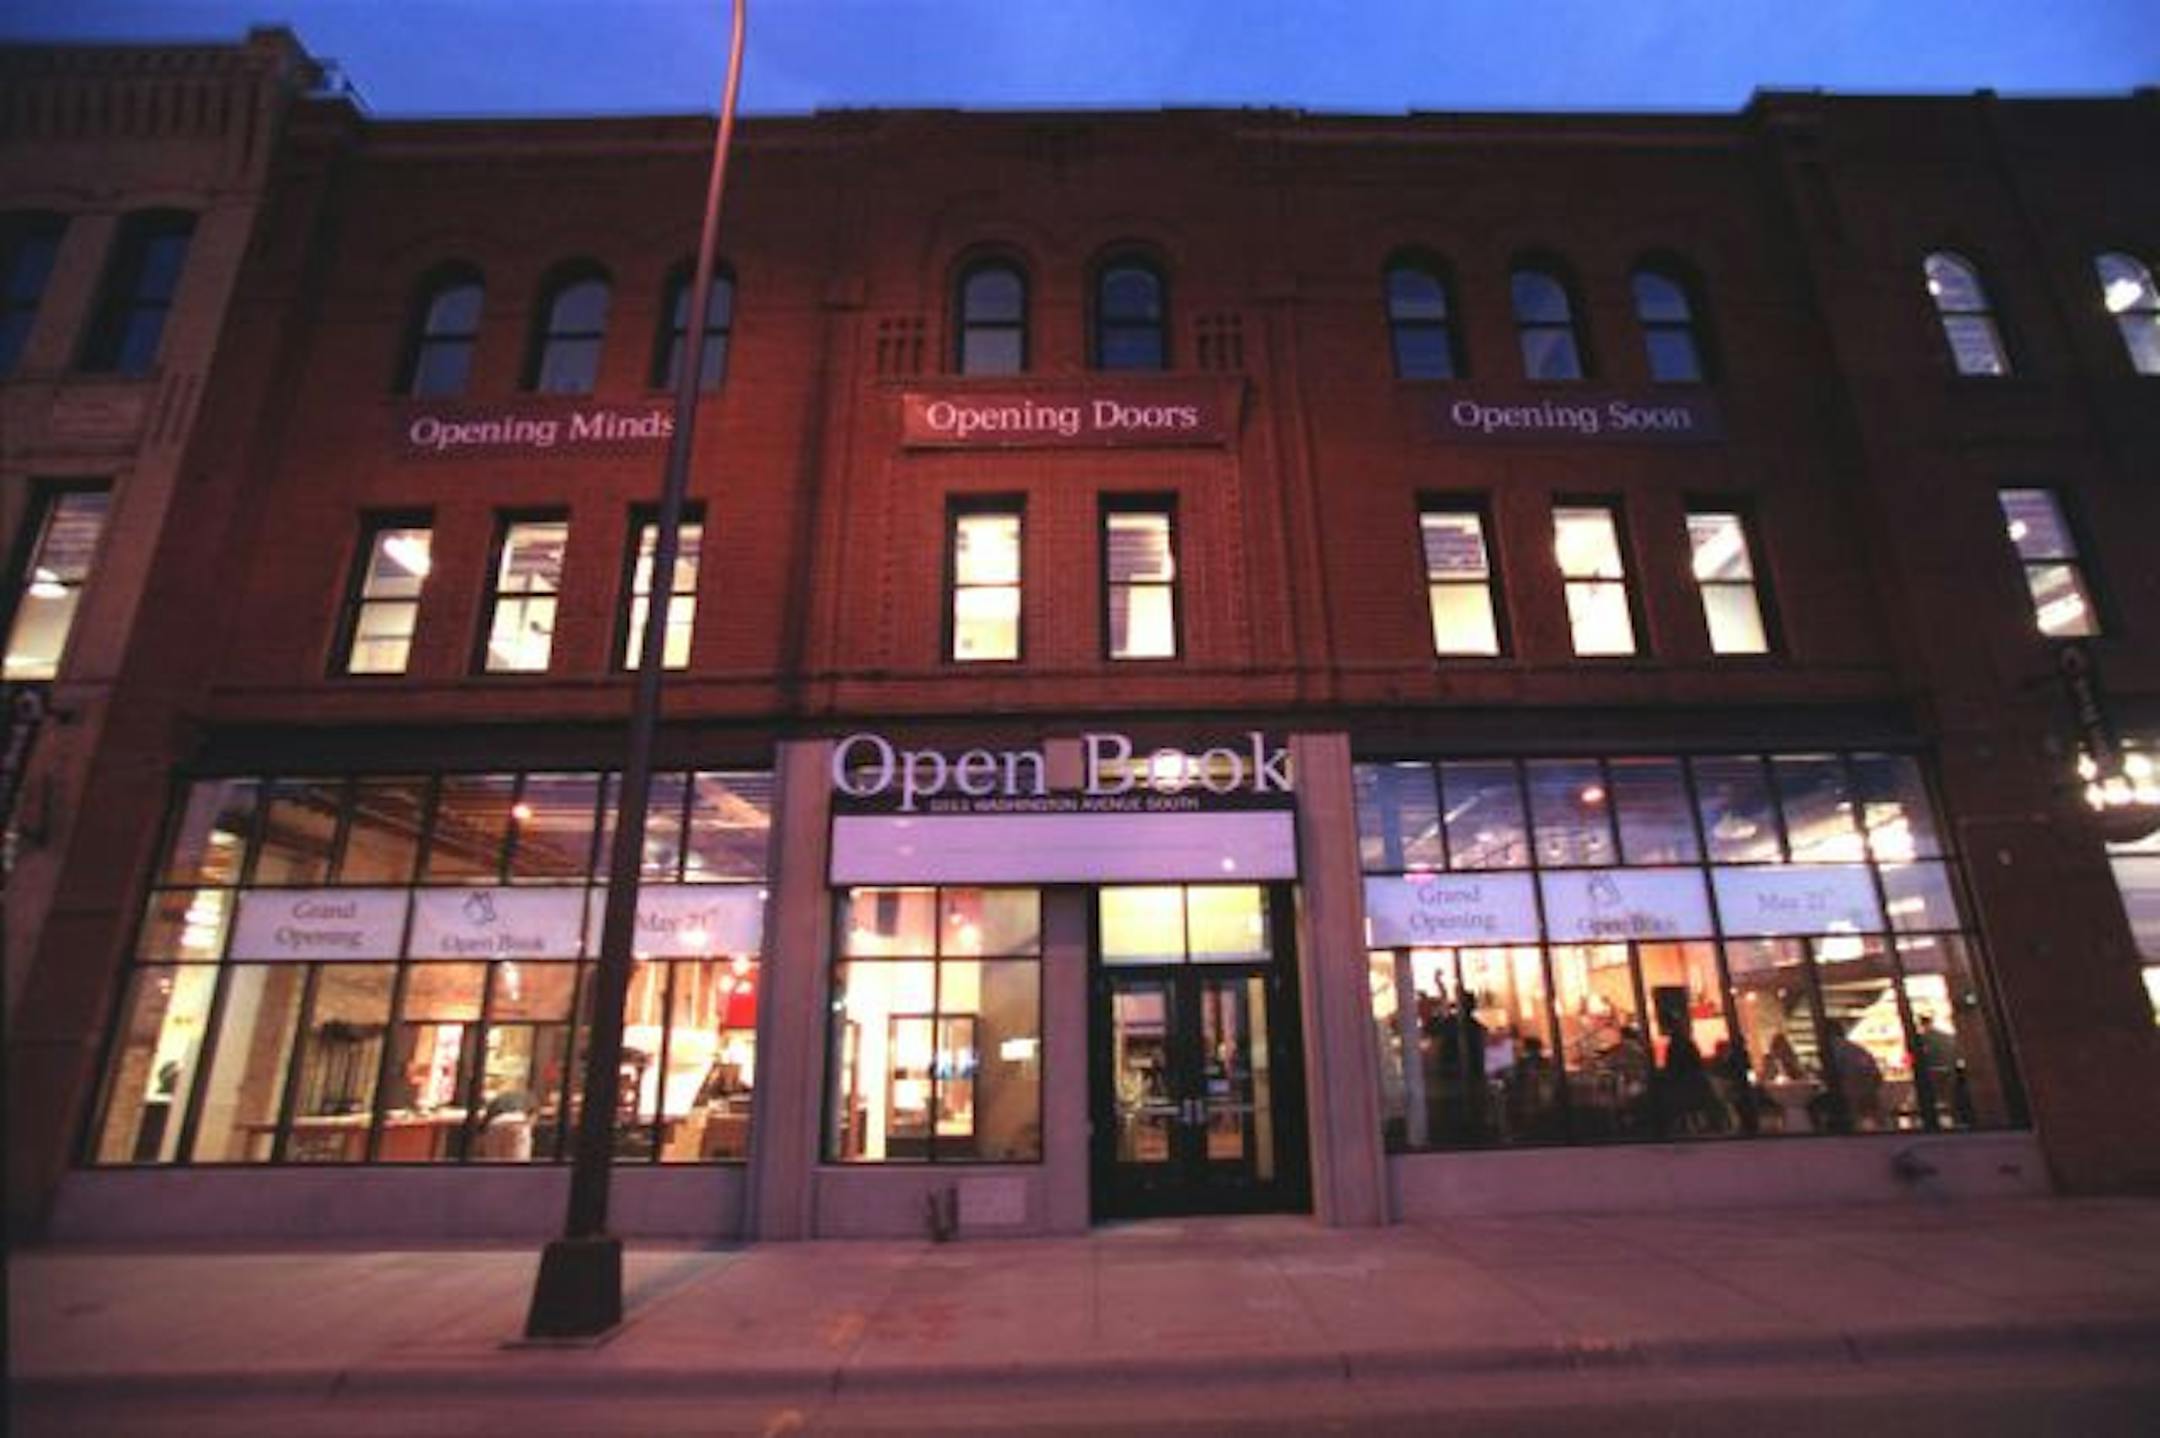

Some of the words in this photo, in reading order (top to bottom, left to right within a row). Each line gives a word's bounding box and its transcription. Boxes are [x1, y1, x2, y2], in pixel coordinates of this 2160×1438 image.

[409, 415, 558, 449] Opening
[569, 409, 675, 441] Minds
[926, 400, 1080, 437] Opening
[1092, 400, 1198, 428] Doors
[1453, 401, 1599, 434] Opening
[1608, 401, 1692, 429] Soon
[832, 733, 1048, 812] Open
[1084, 731, 1293, 795] Book
[974, 799, 1078, 812] WASHINGTON
[1146, 798, 1200, 812] SOUTH
[1417, 886, 1480, 904] Grand
[292, 902, 356, 920] Grand
[1409, 911, 1497, 935] Opening
